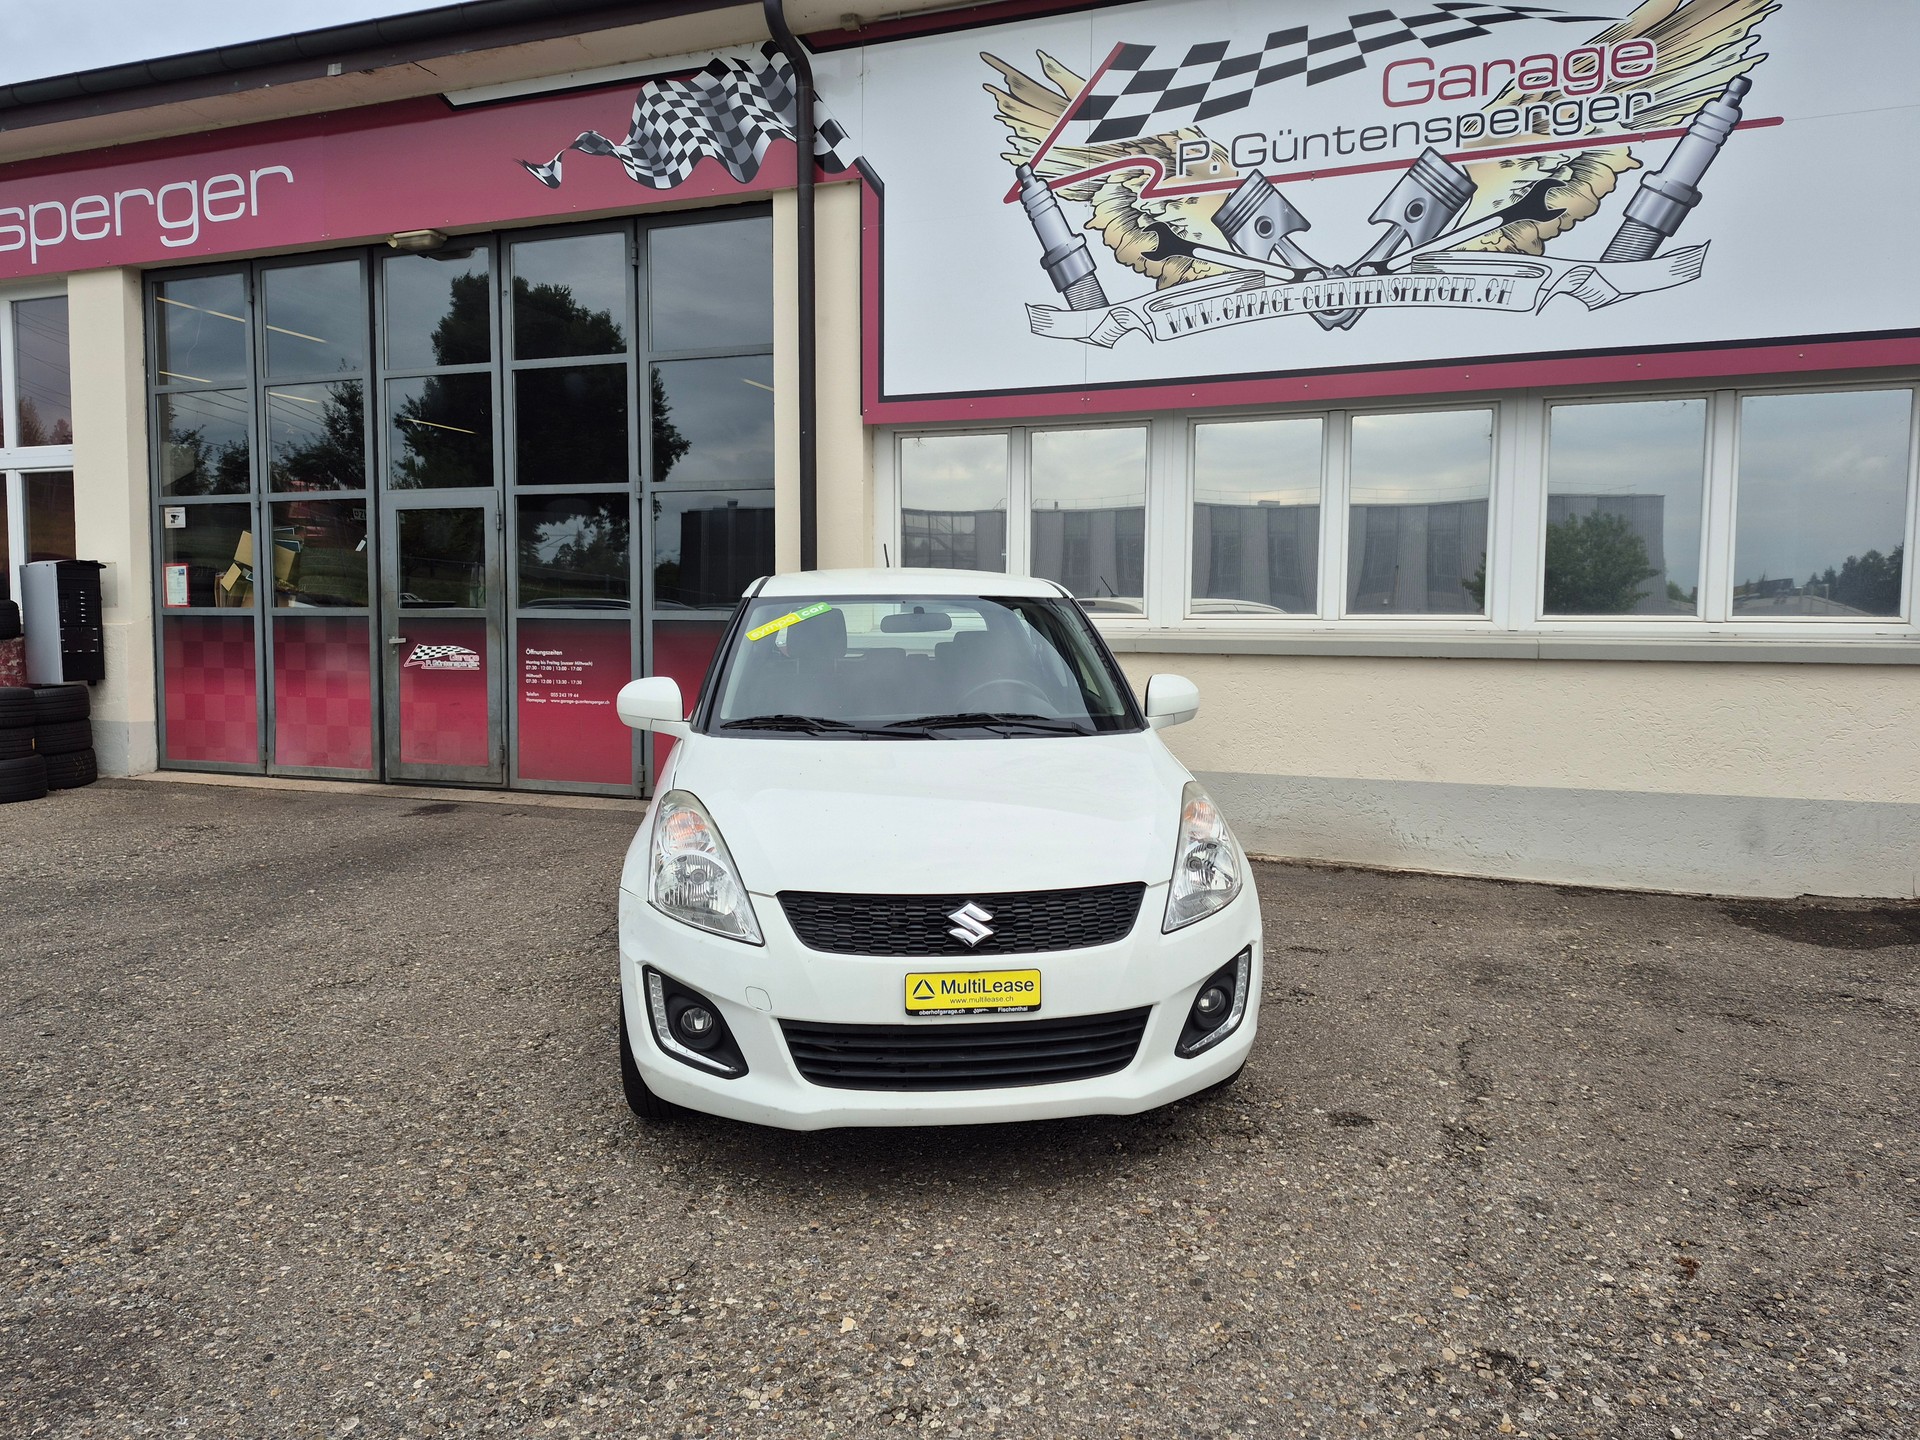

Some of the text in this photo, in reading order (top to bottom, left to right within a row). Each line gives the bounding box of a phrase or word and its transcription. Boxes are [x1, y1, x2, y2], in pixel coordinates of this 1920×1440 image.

[1382, 39, 1654, 108] Garage
[1179, 91, 1652, 176] P. Güntensperger
[1165, 276, 1515, 335] WWW.GARAGE-GUENTENSPERGER.CH
[751, 604, 825, 638] sympa car
[525, 648, 563, 657] Öffnungszeiten
[941, 978, 1034, 994] MultiLease
[950, 996, 1014, 1004] www.multilease.ch
